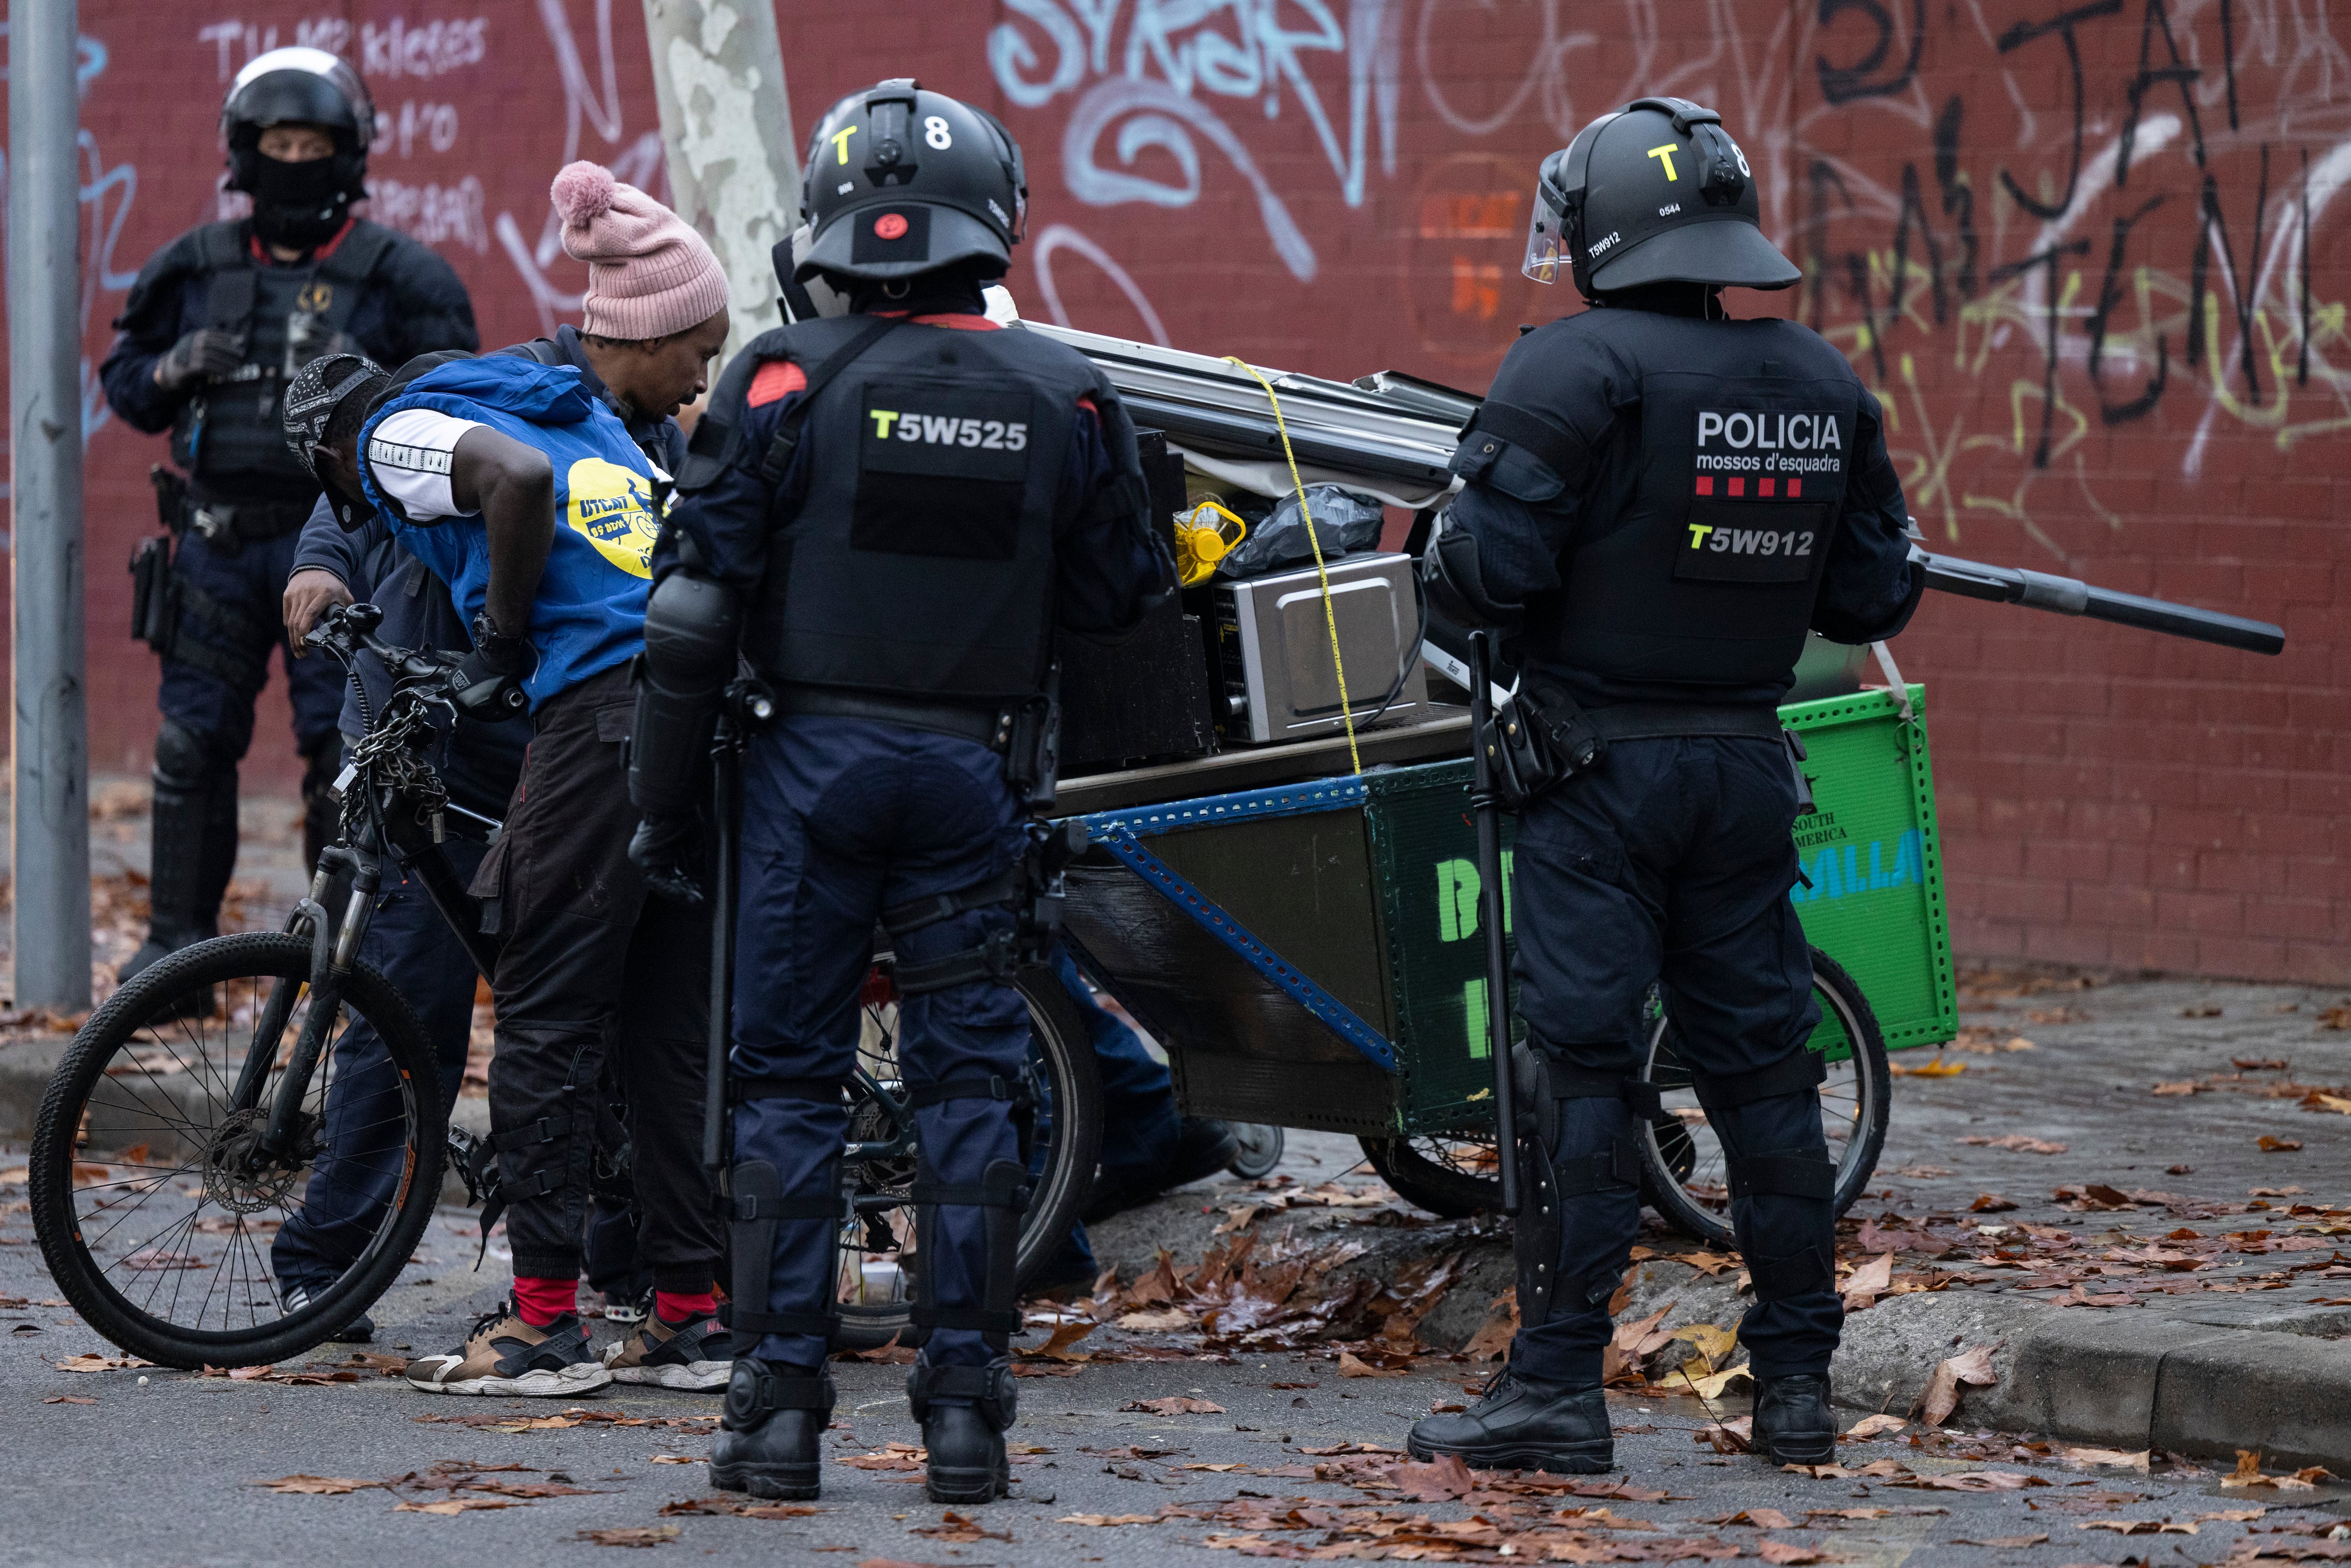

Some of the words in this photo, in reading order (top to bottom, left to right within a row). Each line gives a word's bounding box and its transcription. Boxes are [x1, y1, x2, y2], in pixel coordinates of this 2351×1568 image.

[831, 125, 857, 165] T
[924, 116, 952, 150] 8
[1648, 143, 1678, 181] T
[1731, 143, 1750, 178] 8
[1659, 203, 1680, 217] 0544
[1588, 231, 1621, 259] T5W912
[870, 409, 1027, 451] T5W525
[1697, 412, 1841, 449] POLICIA
[1696, 454, 1760, 470] mossos
[1765, 452, 1840, 474] d'esquadra
[1688, 523, 1814, 556] T5W912
[1791, 812, 1834, 834] SOUTH
[1794, 827, 1847, 848] MERICA
[707, 1320, 731, 1334] NI
